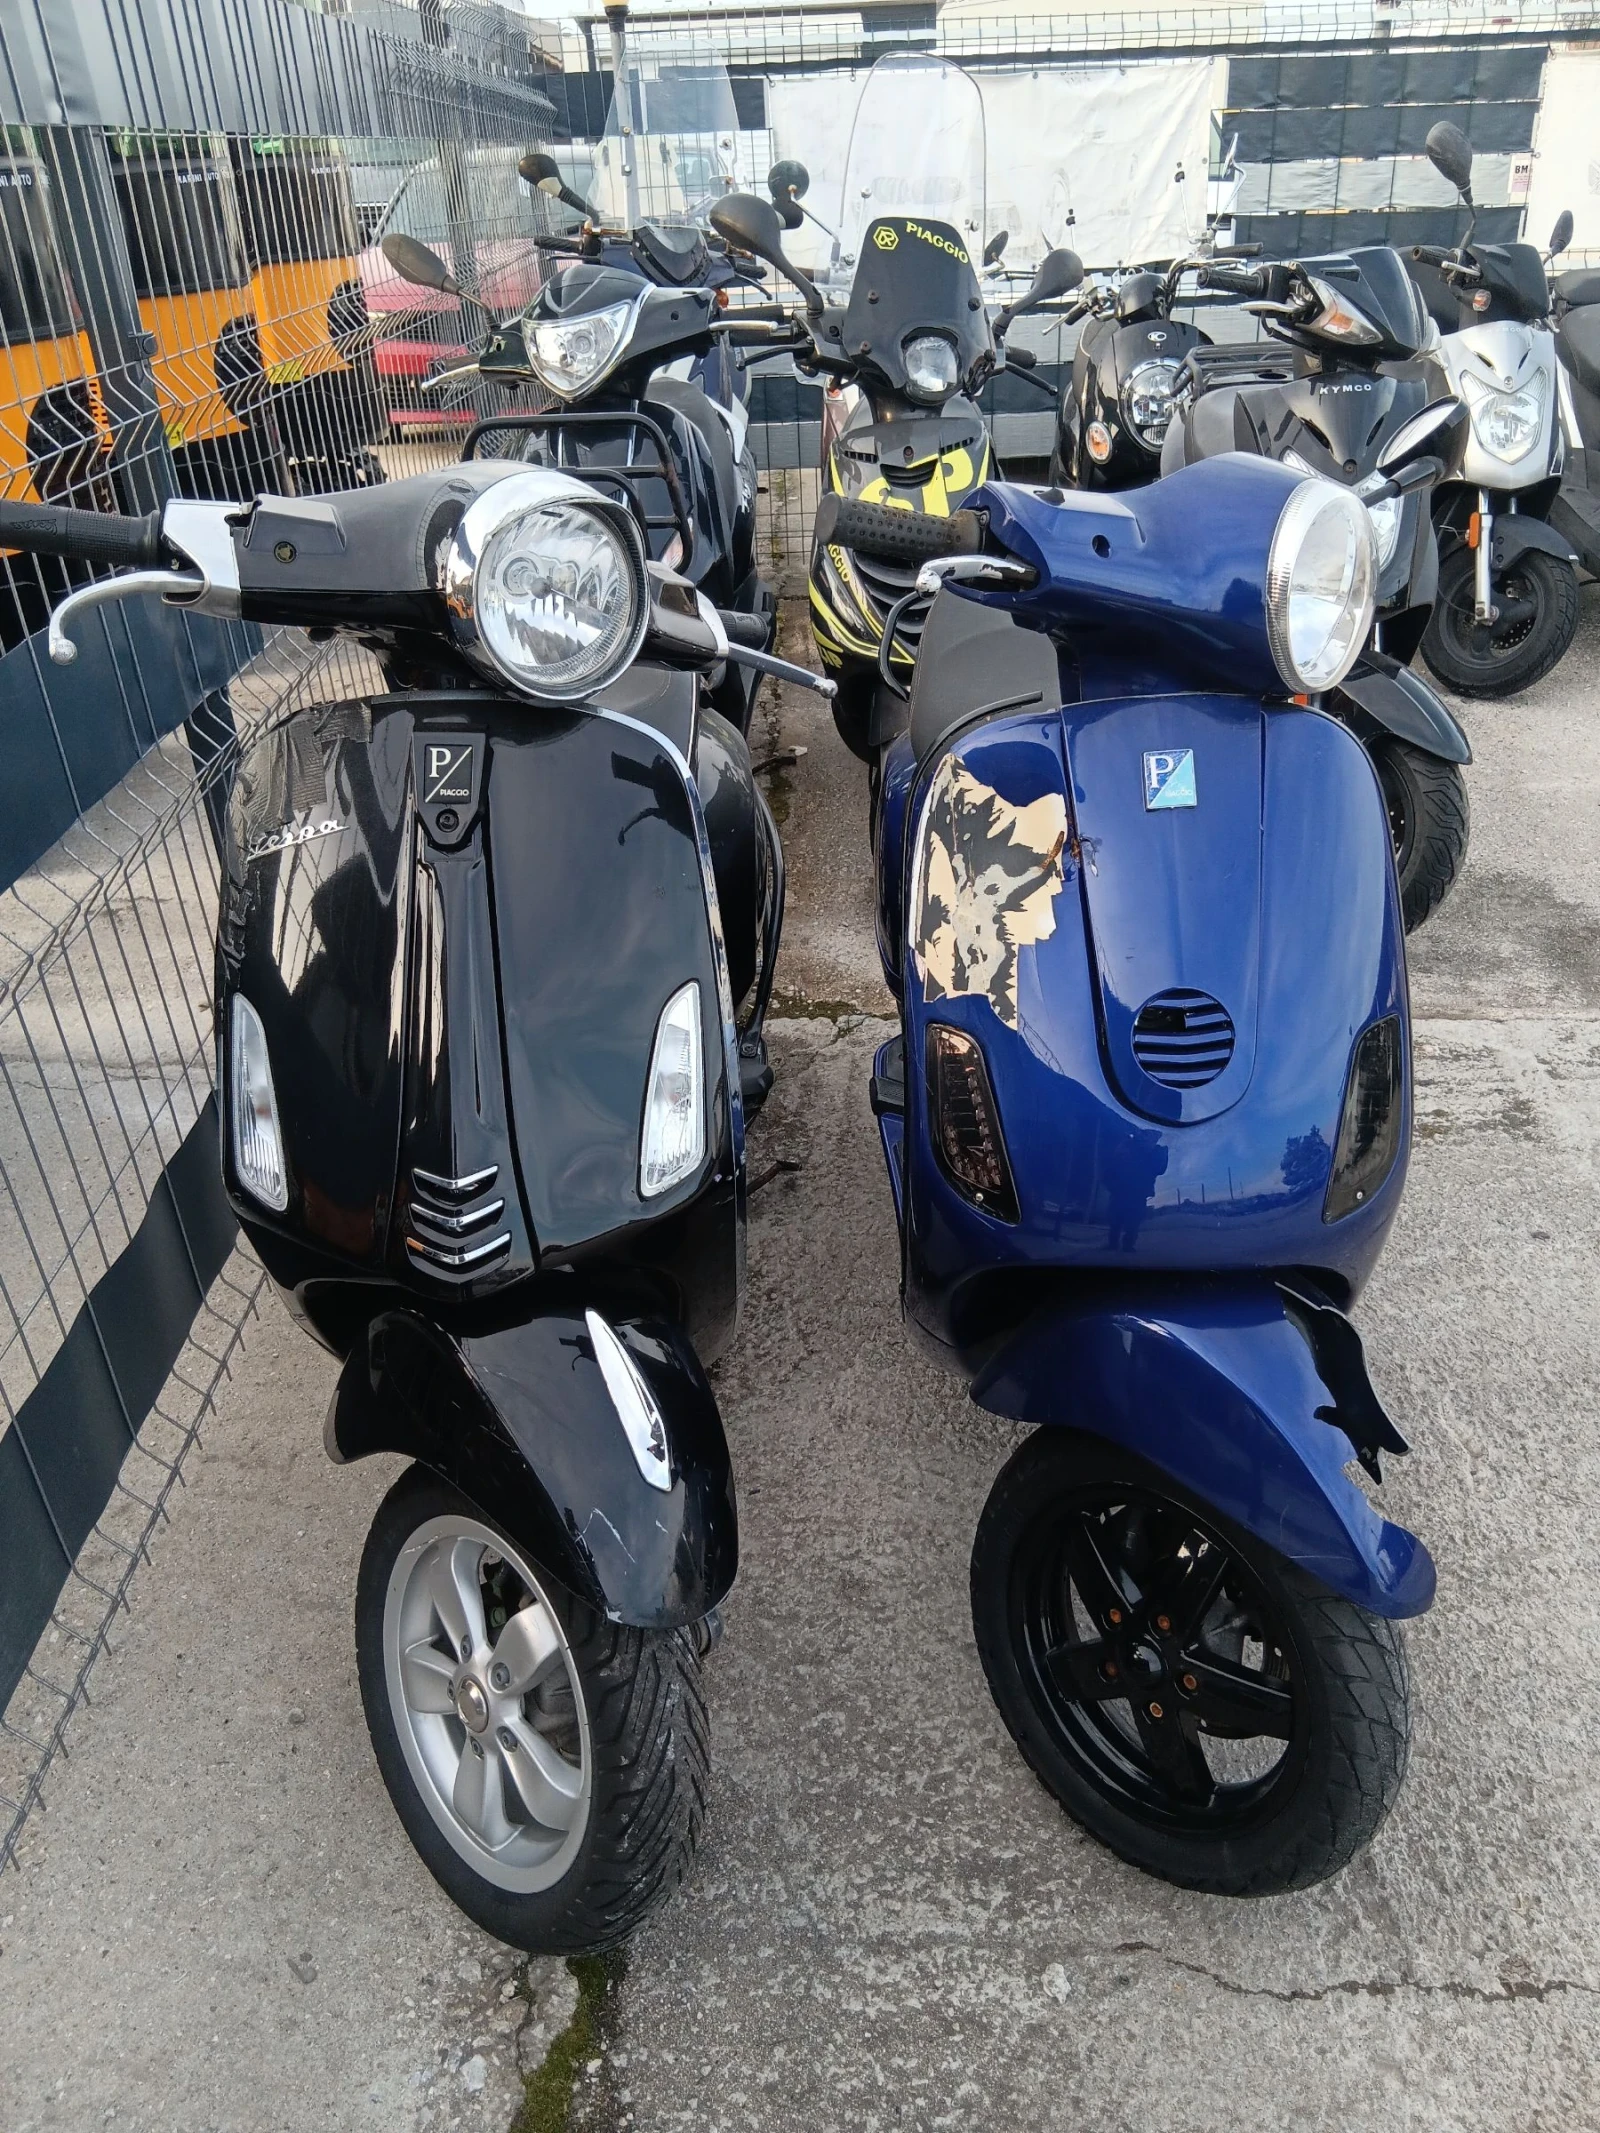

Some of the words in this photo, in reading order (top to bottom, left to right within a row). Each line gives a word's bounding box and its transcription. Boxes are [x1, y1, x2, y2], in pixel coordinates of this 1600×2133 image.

[905, 220, 969, 264] PIAGGIO
[1319, 384, 1372, 395] KYMCO
[828, 543, 851, 583] GGIO
[429, 747, 452, 778] P
[1149, 755, 1174, 789] P
[440, 788, 470, 796] PIAGGIO
